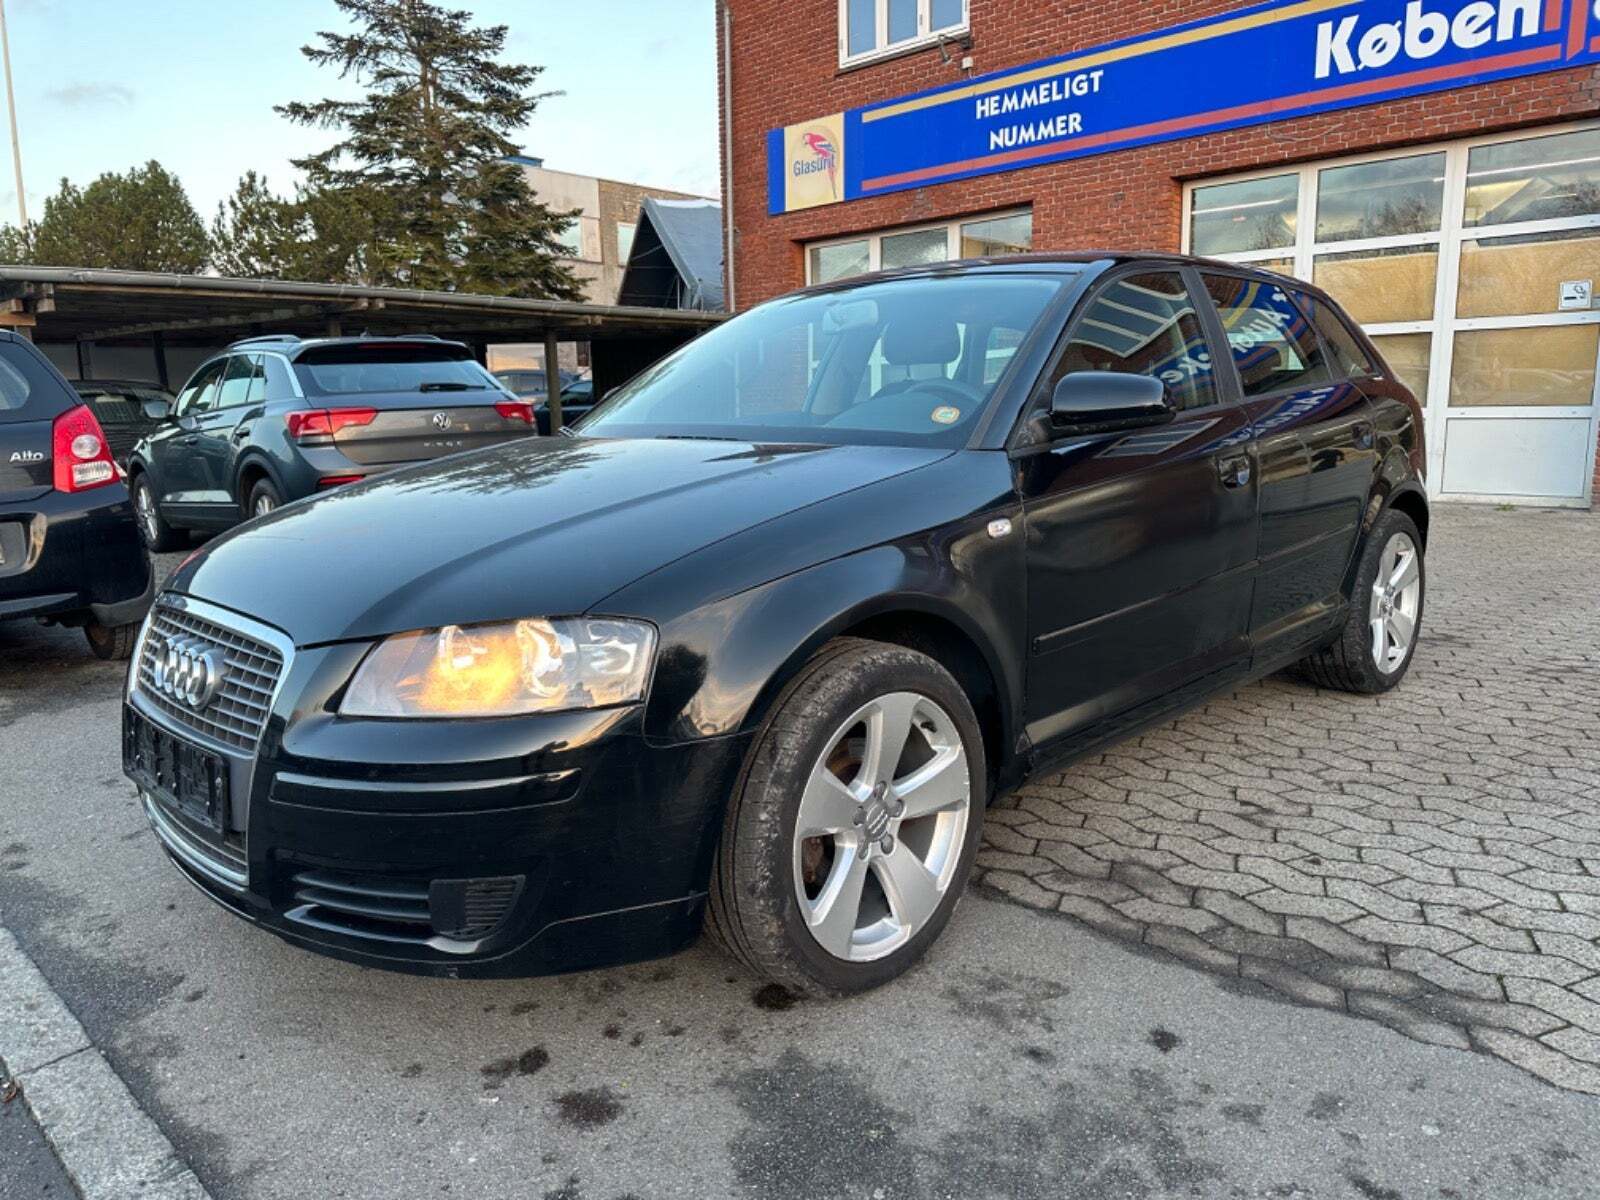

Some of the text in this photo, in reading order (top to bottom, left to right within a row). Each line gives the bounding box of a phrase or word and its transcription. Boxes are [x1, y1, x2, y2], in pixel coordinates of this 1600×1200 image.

[975, 69, 1104, 120] HEMMELIGT
[989, 112, 1083, 151] NUMMER
[8, 449, 45, 464] Alto
